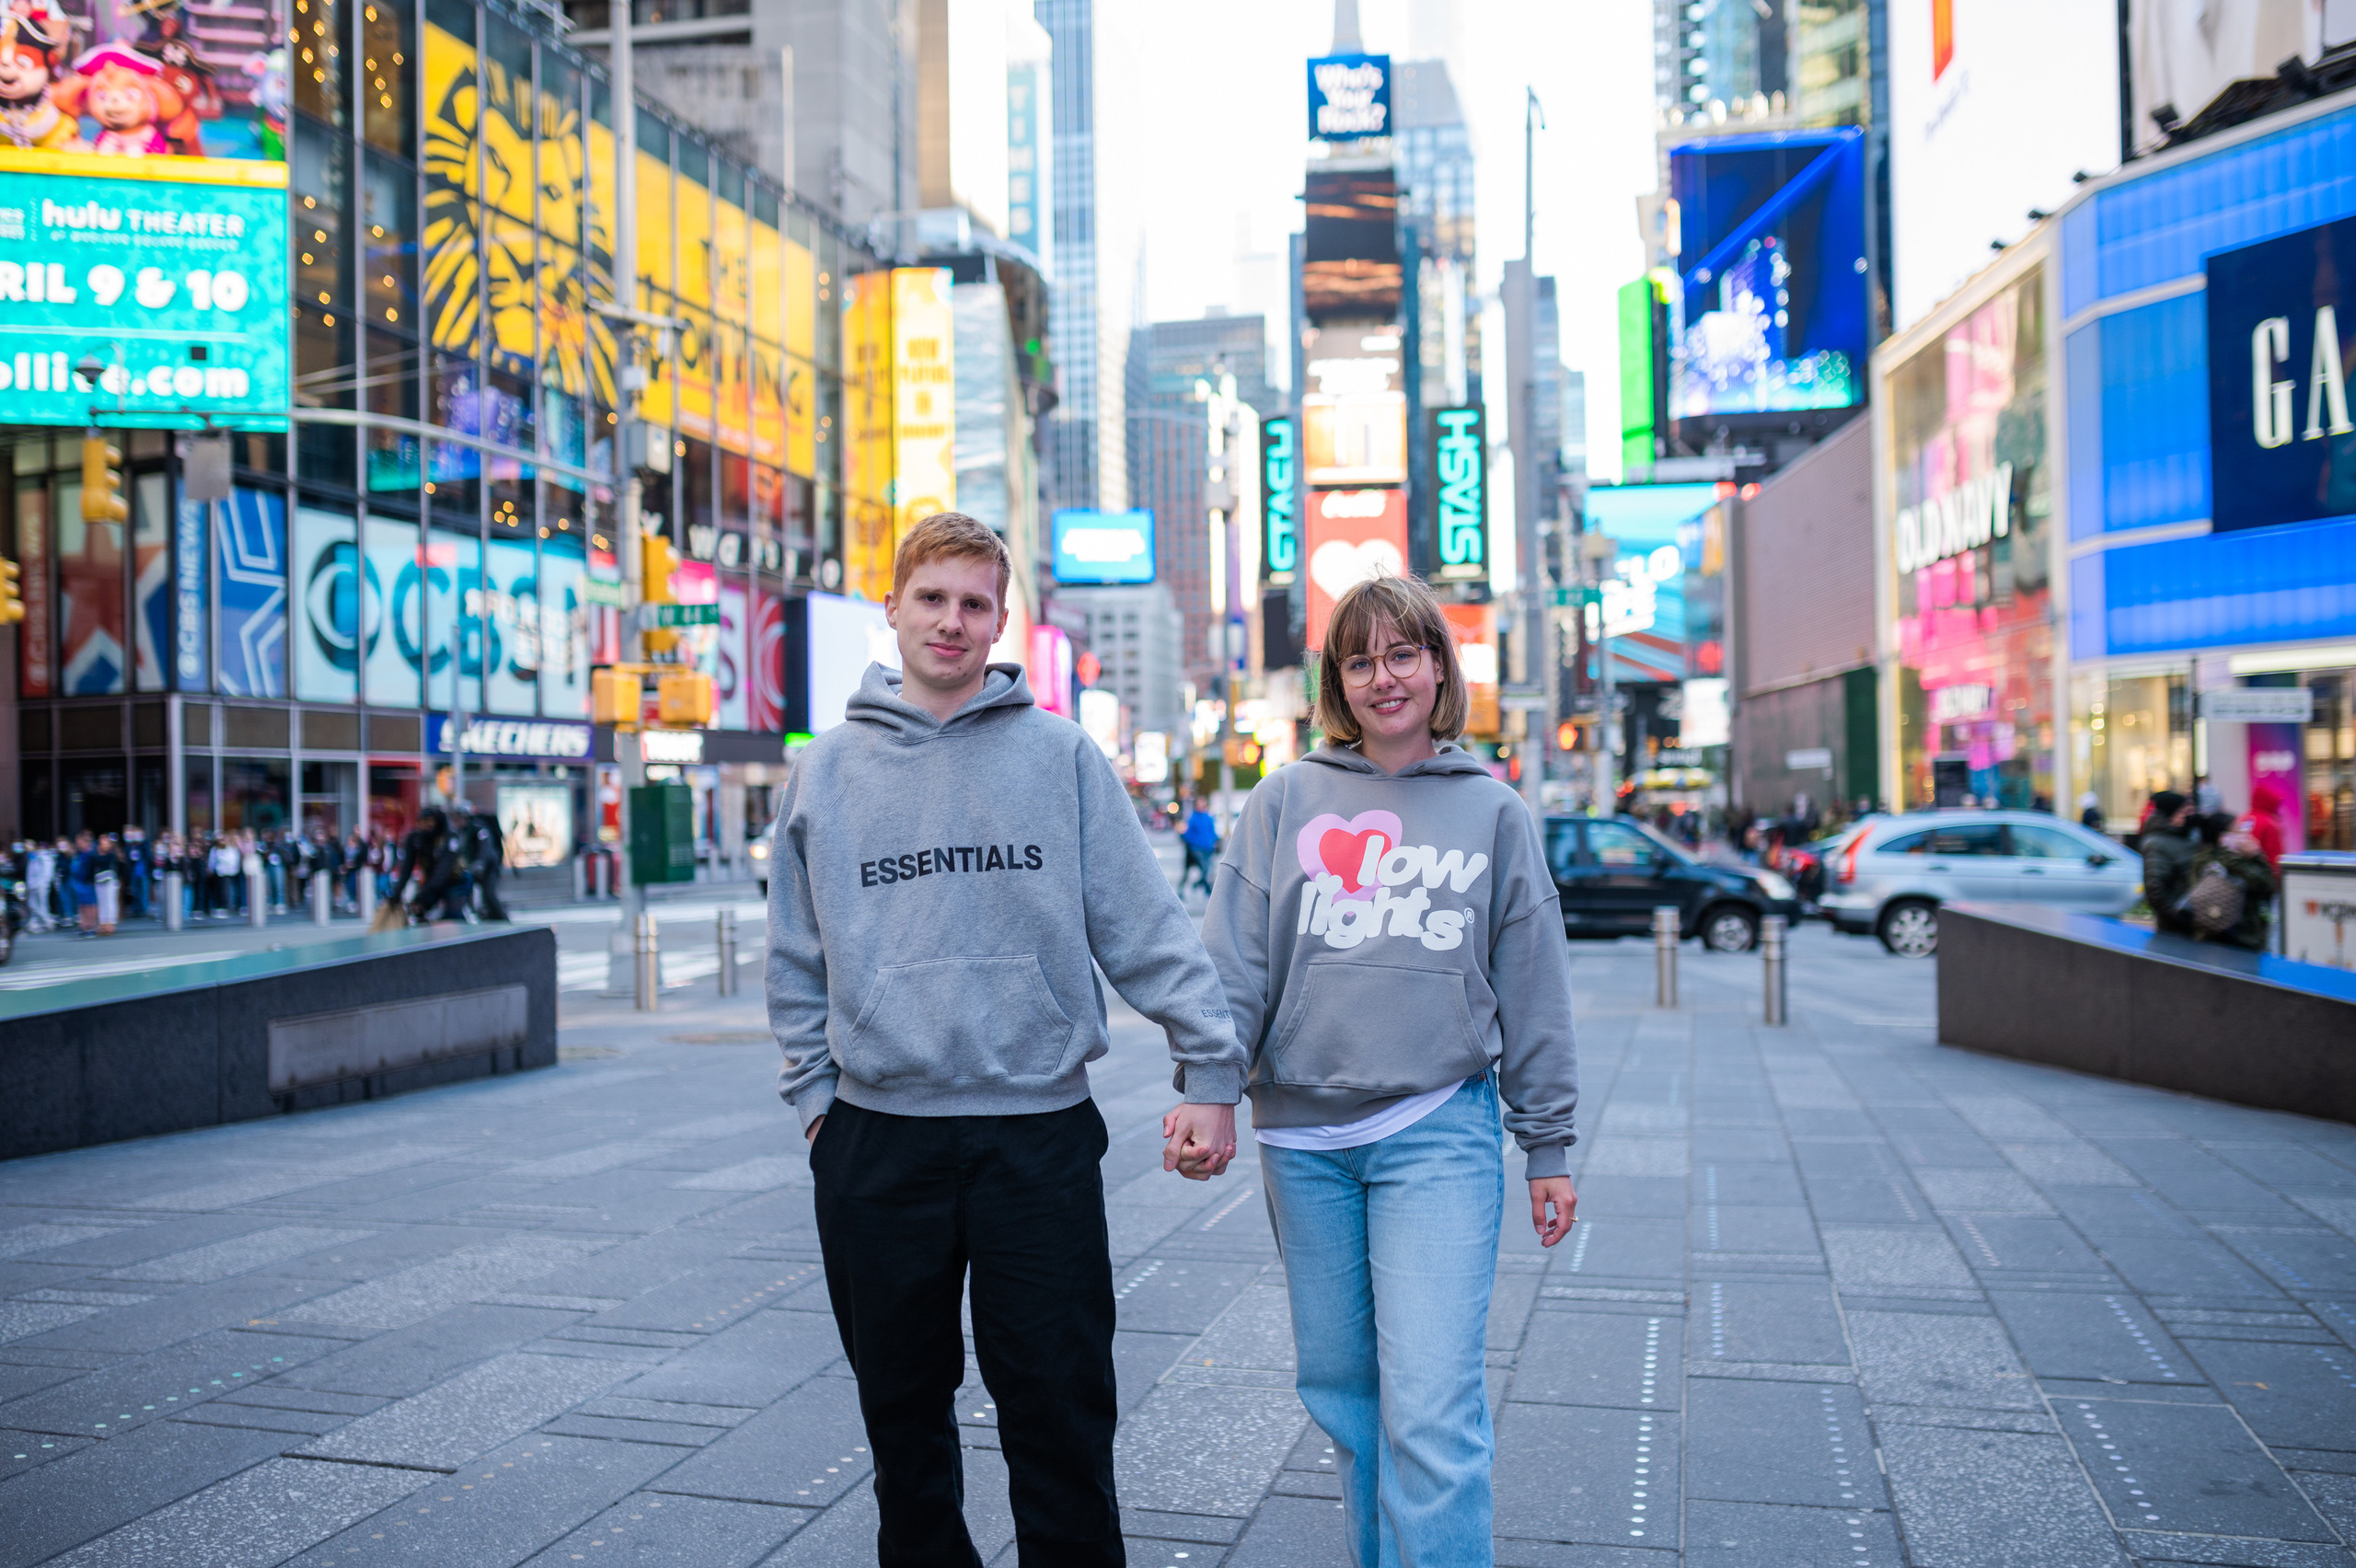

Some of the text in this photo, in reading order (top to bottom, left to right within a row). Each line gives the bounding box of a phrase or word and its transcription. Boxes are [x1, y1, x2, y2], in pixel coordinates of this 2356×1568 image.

[42, 198, 121, 230] hulu
[125, 208, 245, 238] THEATER
[87, 264, 125, 306] 9
[135, 267, 177, 308] &
[185, 269, 249, 312] 10
[1438, 410, 1483, 564] STASH
[860, 844, 1044, 888] ESSENTIALS
[1357, 835, 1488, 894] low
